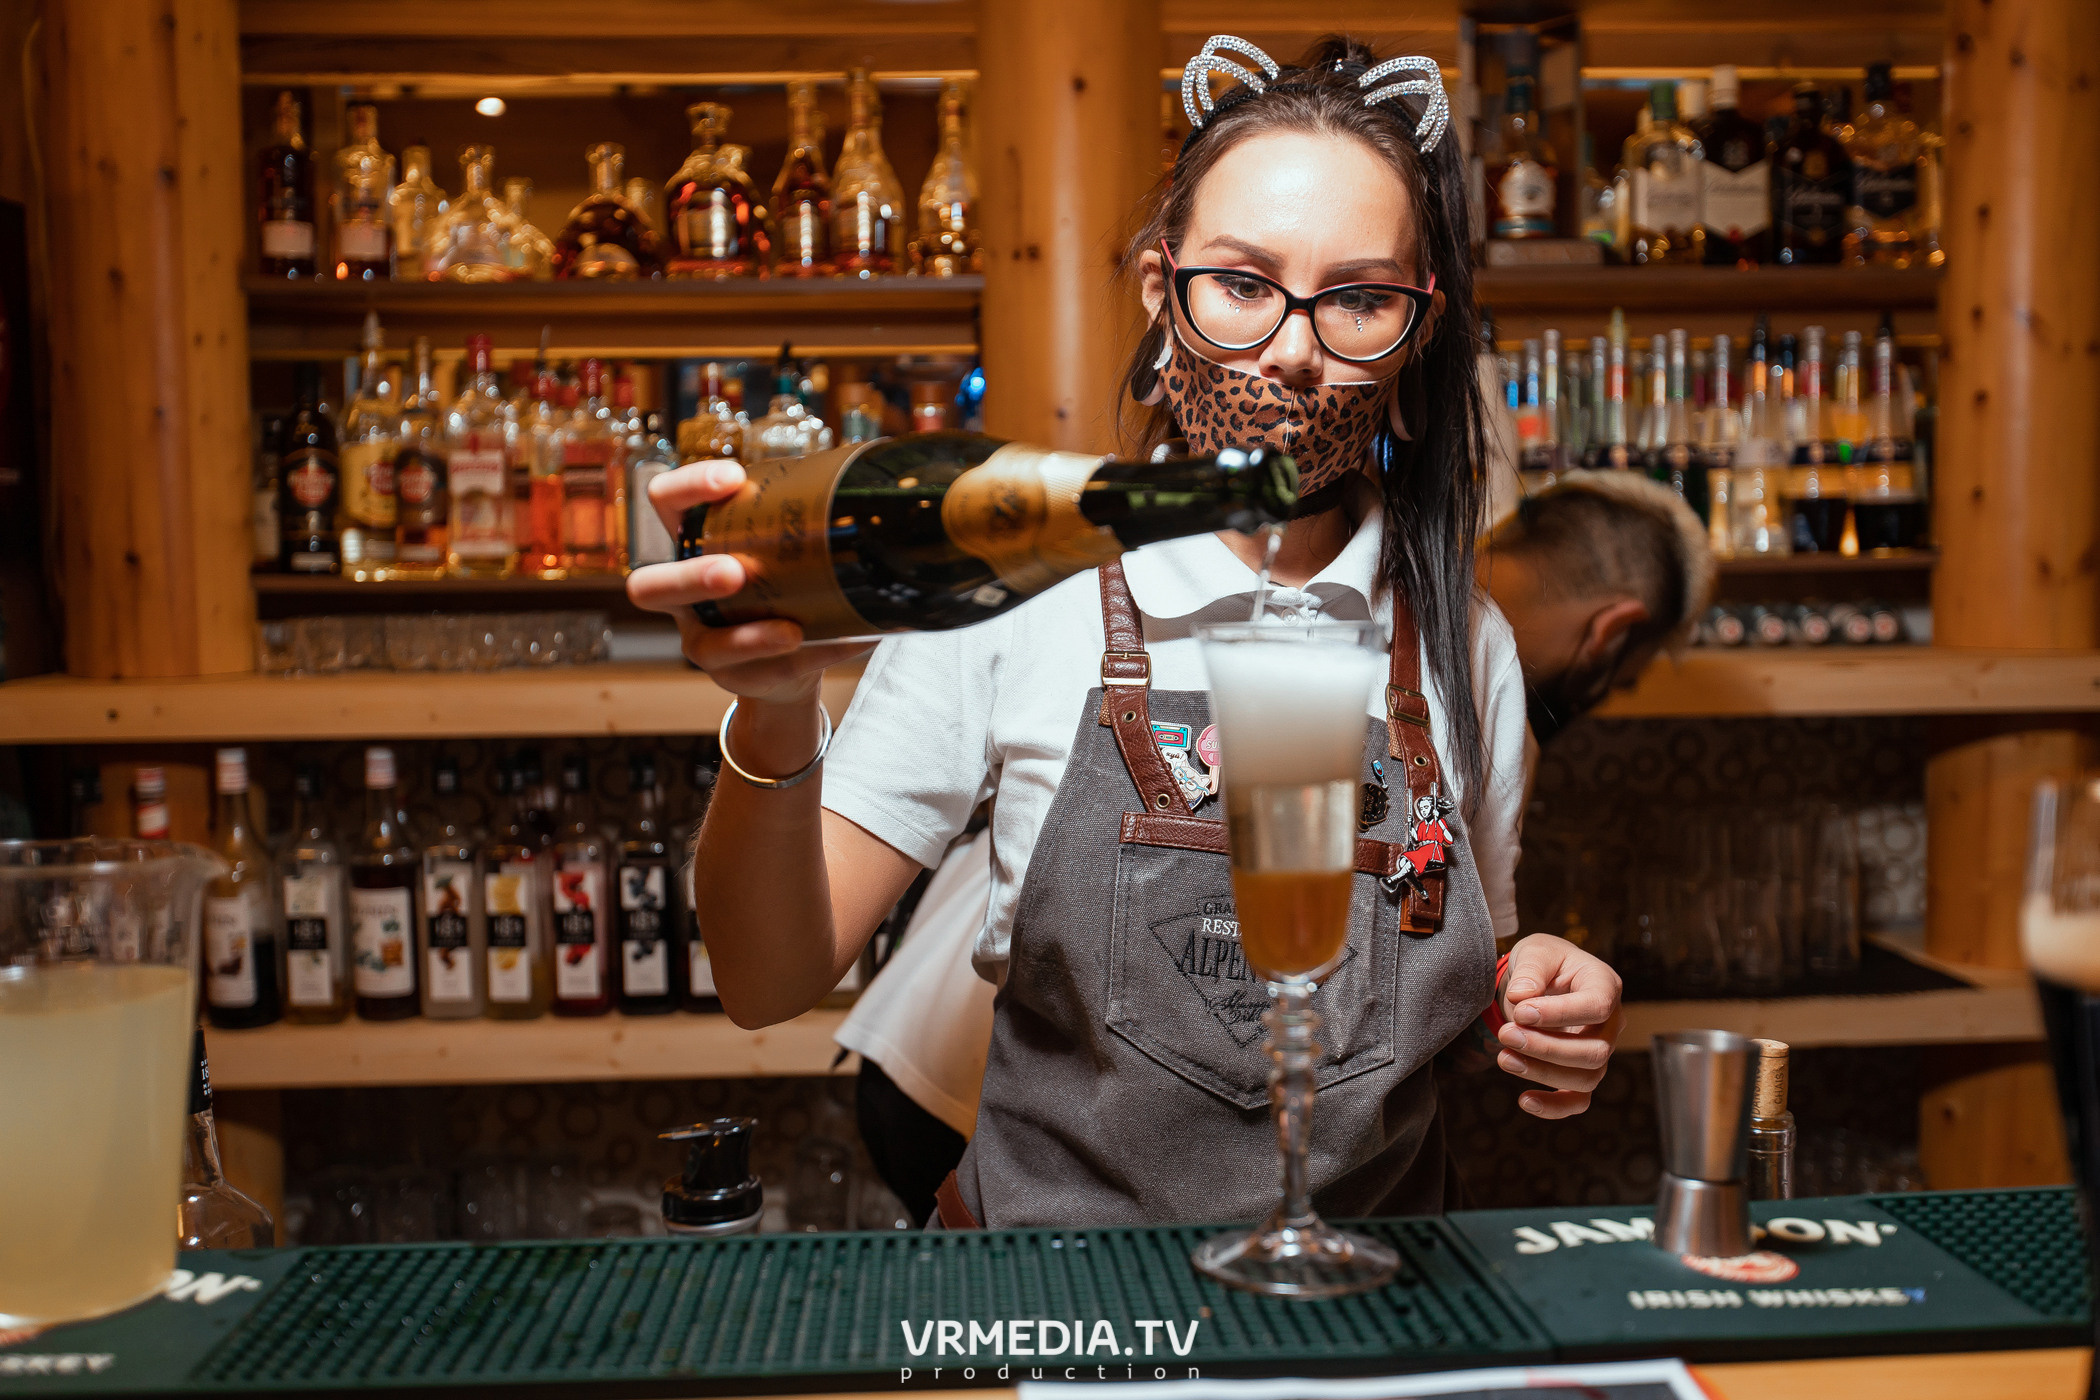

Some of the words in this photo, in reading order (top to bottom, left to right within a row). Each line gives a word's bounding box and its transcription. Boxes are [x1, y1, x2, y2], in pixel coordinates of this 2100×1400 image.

[1203, 902, 1237, 915] GRA
[1202, 917, 1242, 937] REST
[1513, 1217, 1885, 1255] JAMON
[1628, 1288, 1744, 1310] IRISH
